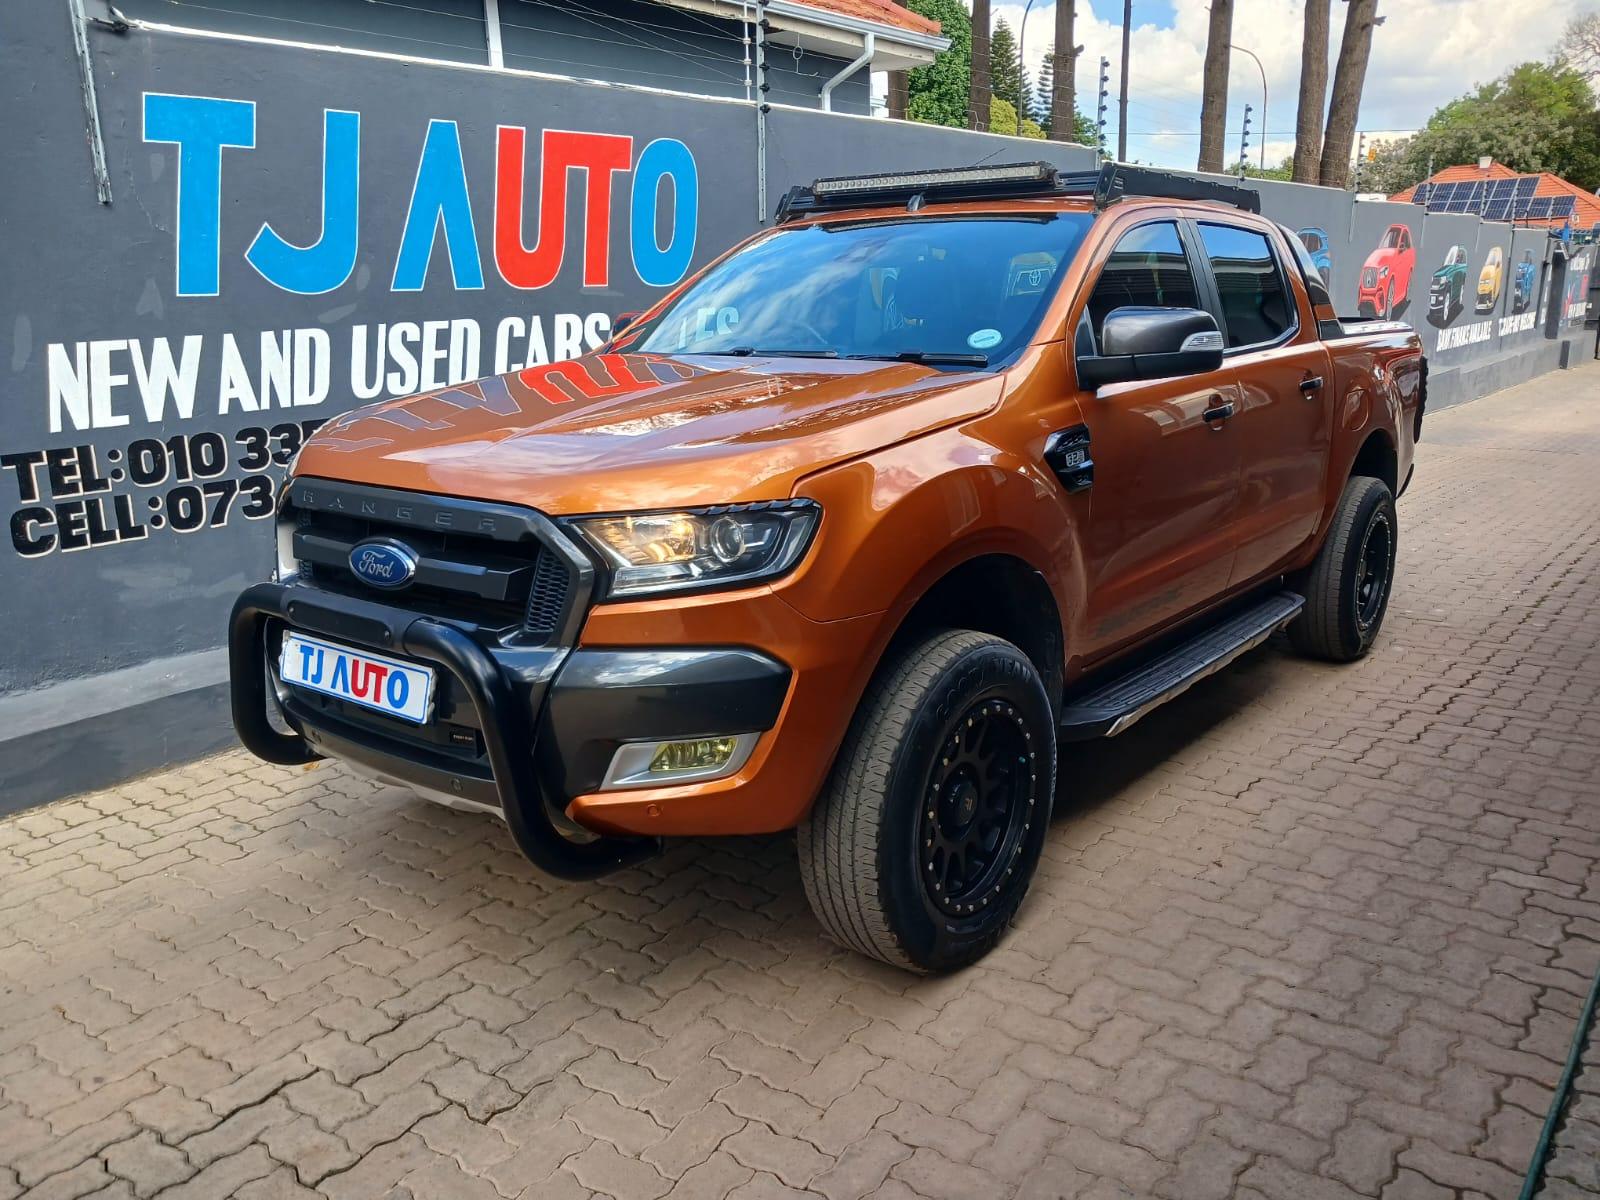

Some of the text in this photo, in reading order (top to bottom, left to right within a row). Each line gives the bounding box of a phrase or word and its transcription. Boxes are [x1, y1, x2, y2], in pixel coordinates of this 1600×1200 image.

[142, 92, 698, 297] TJ AUTO
[48, 335, 203, 433] NEW
[218, 328, 331, 415] AND
[350, 318, 481, 399] USED
[495, 312, 610, 375] CARS
[303, 488, 497, 532] RANGER
[358, 550, 395, 578] Ford
[300, 644, 409, 709] TJ AUTO
